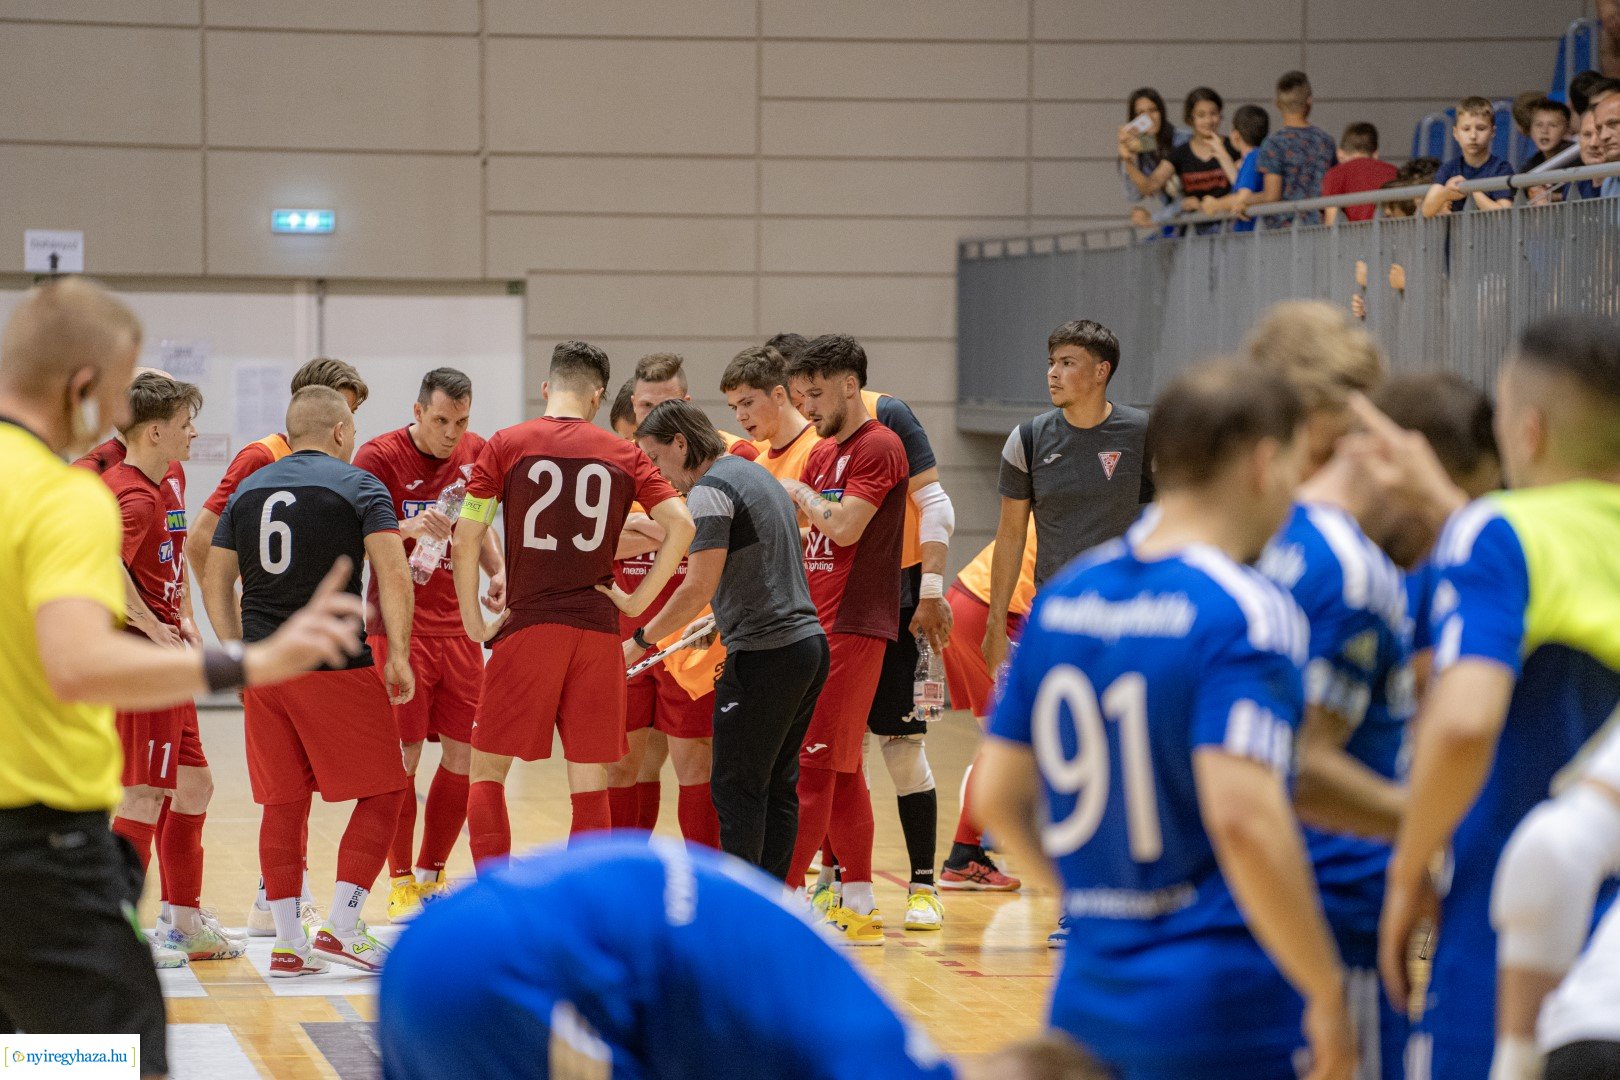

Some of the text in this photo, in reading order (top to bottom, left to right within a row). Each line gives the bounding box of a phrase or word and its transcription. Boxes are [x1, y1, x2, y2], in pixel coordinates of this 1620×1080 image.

[259, 490, 297, 575] 6
[523, 459, 612, 552] 29
[1031, 663, 1163, 863] 91
